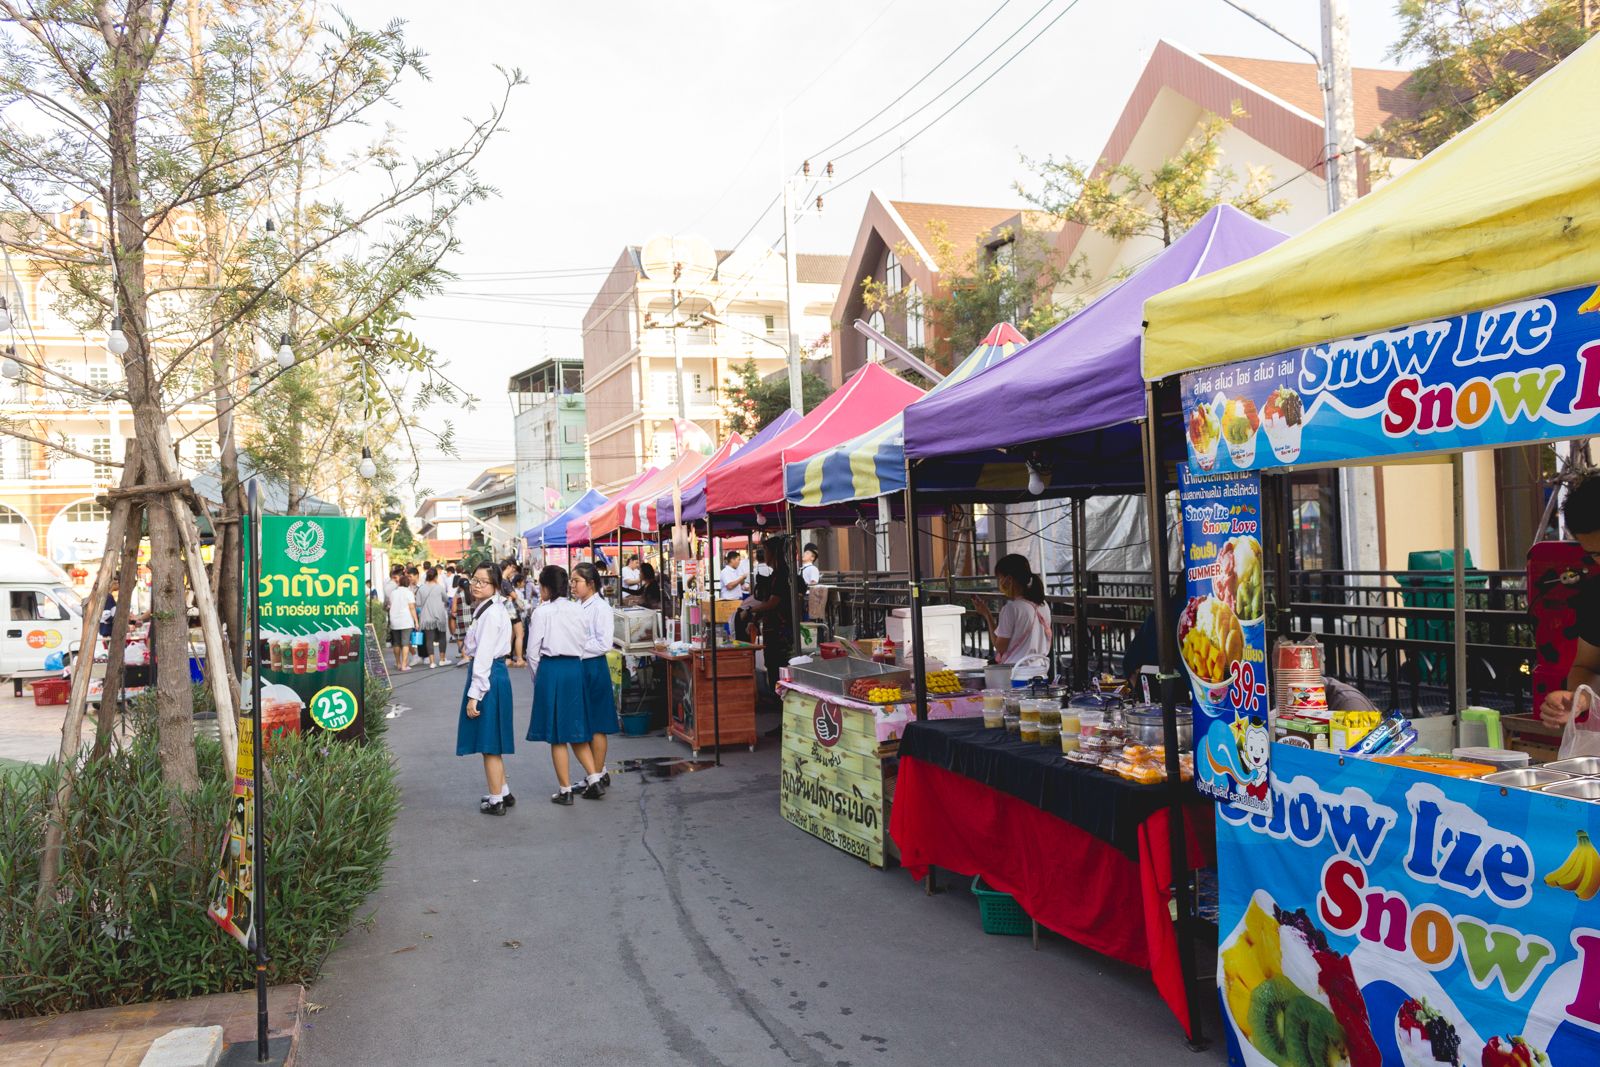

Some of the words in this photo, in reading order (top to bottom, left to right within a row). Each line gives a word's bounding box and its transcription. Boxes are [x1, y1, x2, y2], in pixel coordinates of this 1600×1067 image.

[1298, 317, 1453, 396] Snow
[1453, 299, 1556, 367] Ize
[1382, 368, 1563, 437] Snow
[1185, 504, 1213, 522] Snow
[1202, 520, 1231, 535] Snow
[1231, 518, 1257, 534] Love
[1188, 563, 1221, 582] SUMMER
[259, 601, 273, 616] าดี
[276, 600, 320, 616] ชาอร่อย
[317, 692, 348, 720] 25
[329, 714, 348, 727] บาท
[1361, 725, 1387, 751] OREO
[1403, 782, 1535, 908] Ize
[1317, 857, 1556, 1001] Snow
